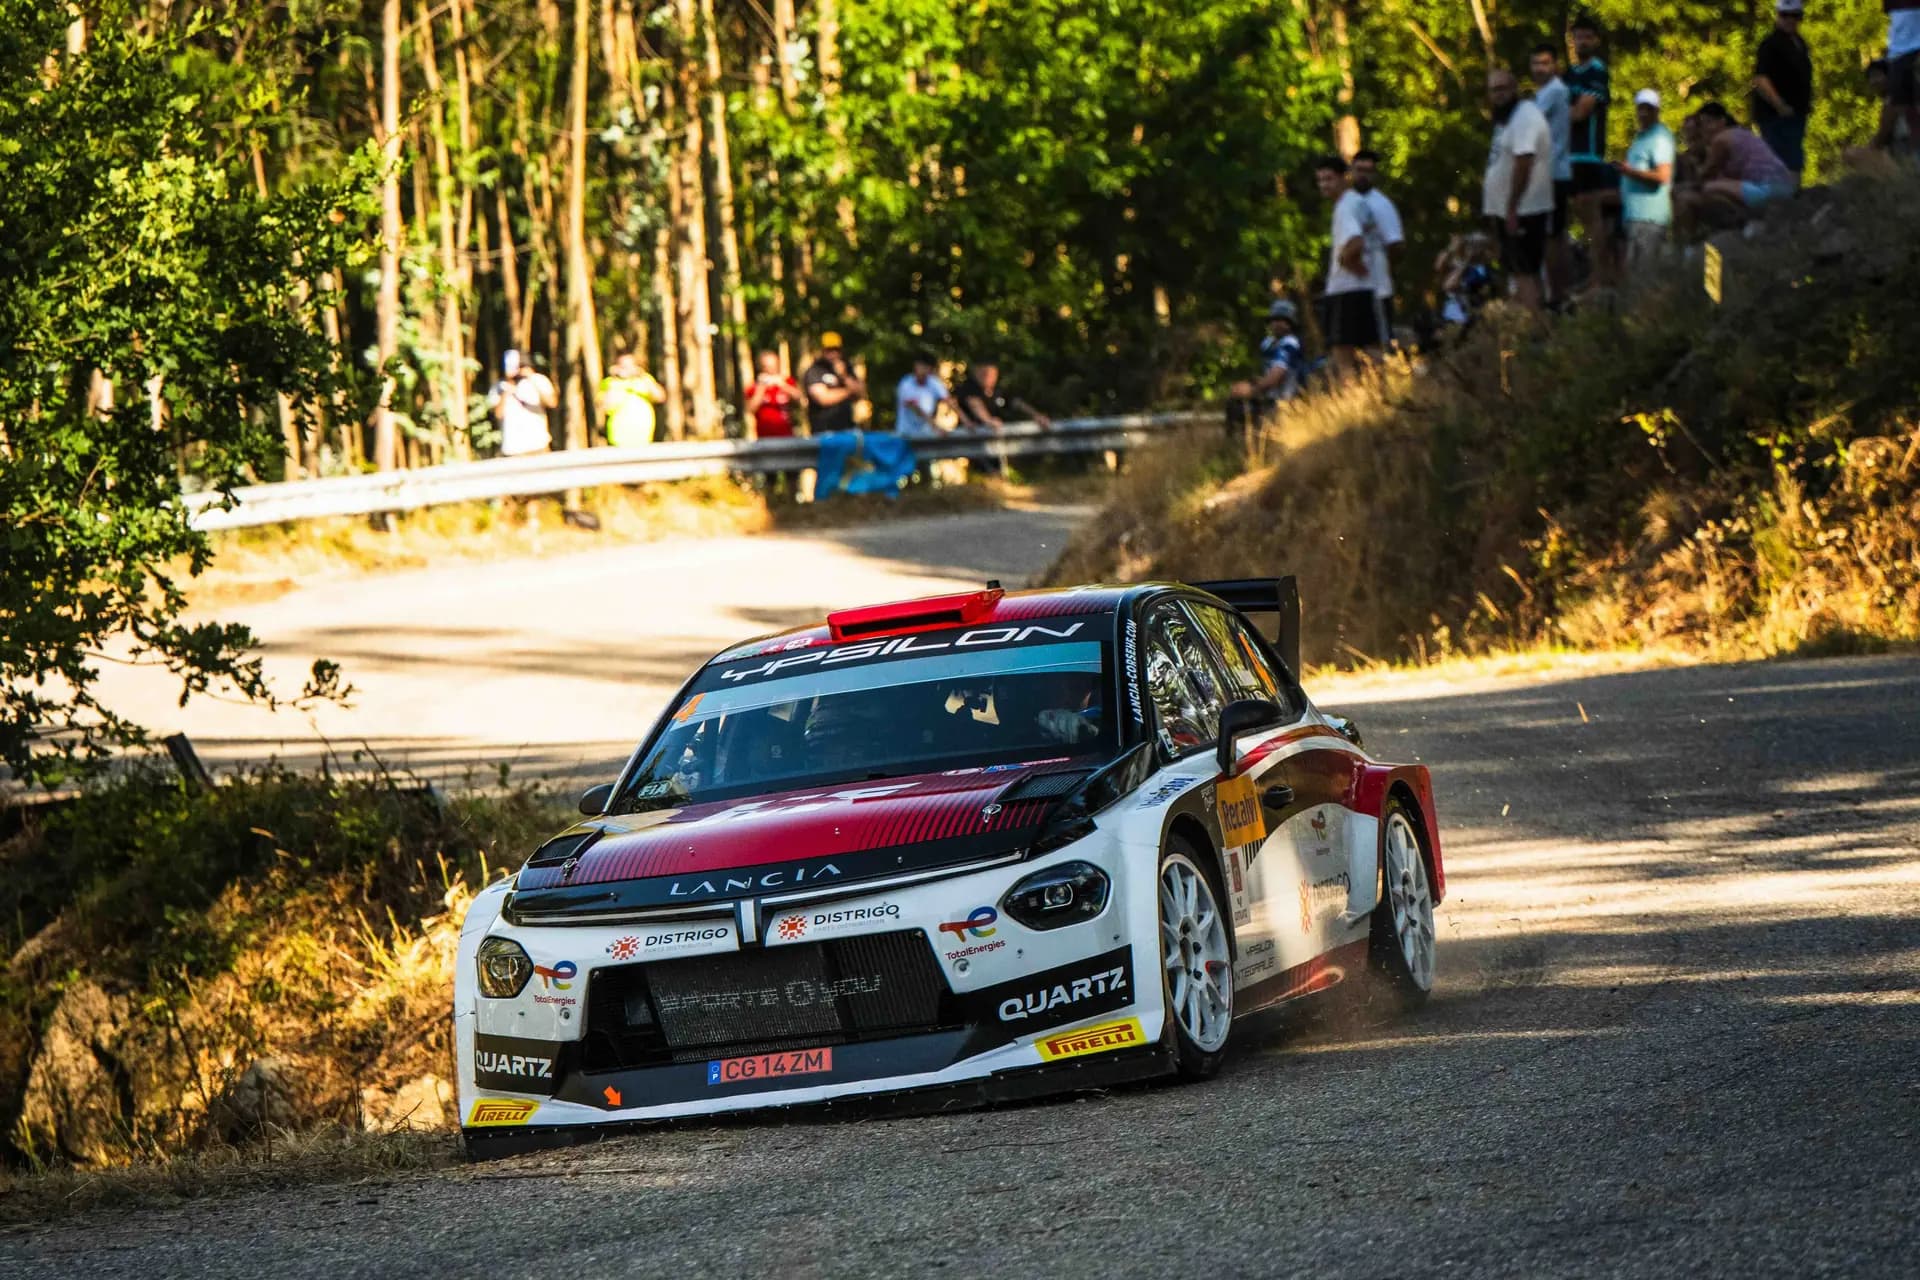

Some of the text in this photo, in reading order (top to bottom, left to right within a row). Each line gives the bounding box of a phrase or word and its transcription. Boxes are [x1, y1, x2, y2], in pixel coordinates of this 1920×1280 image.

[720, 622, 1084, 681] YPSILON
[1222, 790, 1259, 832] Recalvi
[669, 863, 842, 896] LANCIA
[814, 904, 900, 925] DISTRIGO
[645, 927, 729, 946] DISTRIGO
[945, 939, 1006, 960] TotalEnergies
[534, 994, 576, 1006] TotalEnergies
[998, 966, 1127, 1021] QUARTZ
[1046, 1023, 1136, 1056] PIRELLI
[476, 1050, 552, 1078] QUARTZ
[473, 1104, 534, 1122] PIRELLI
